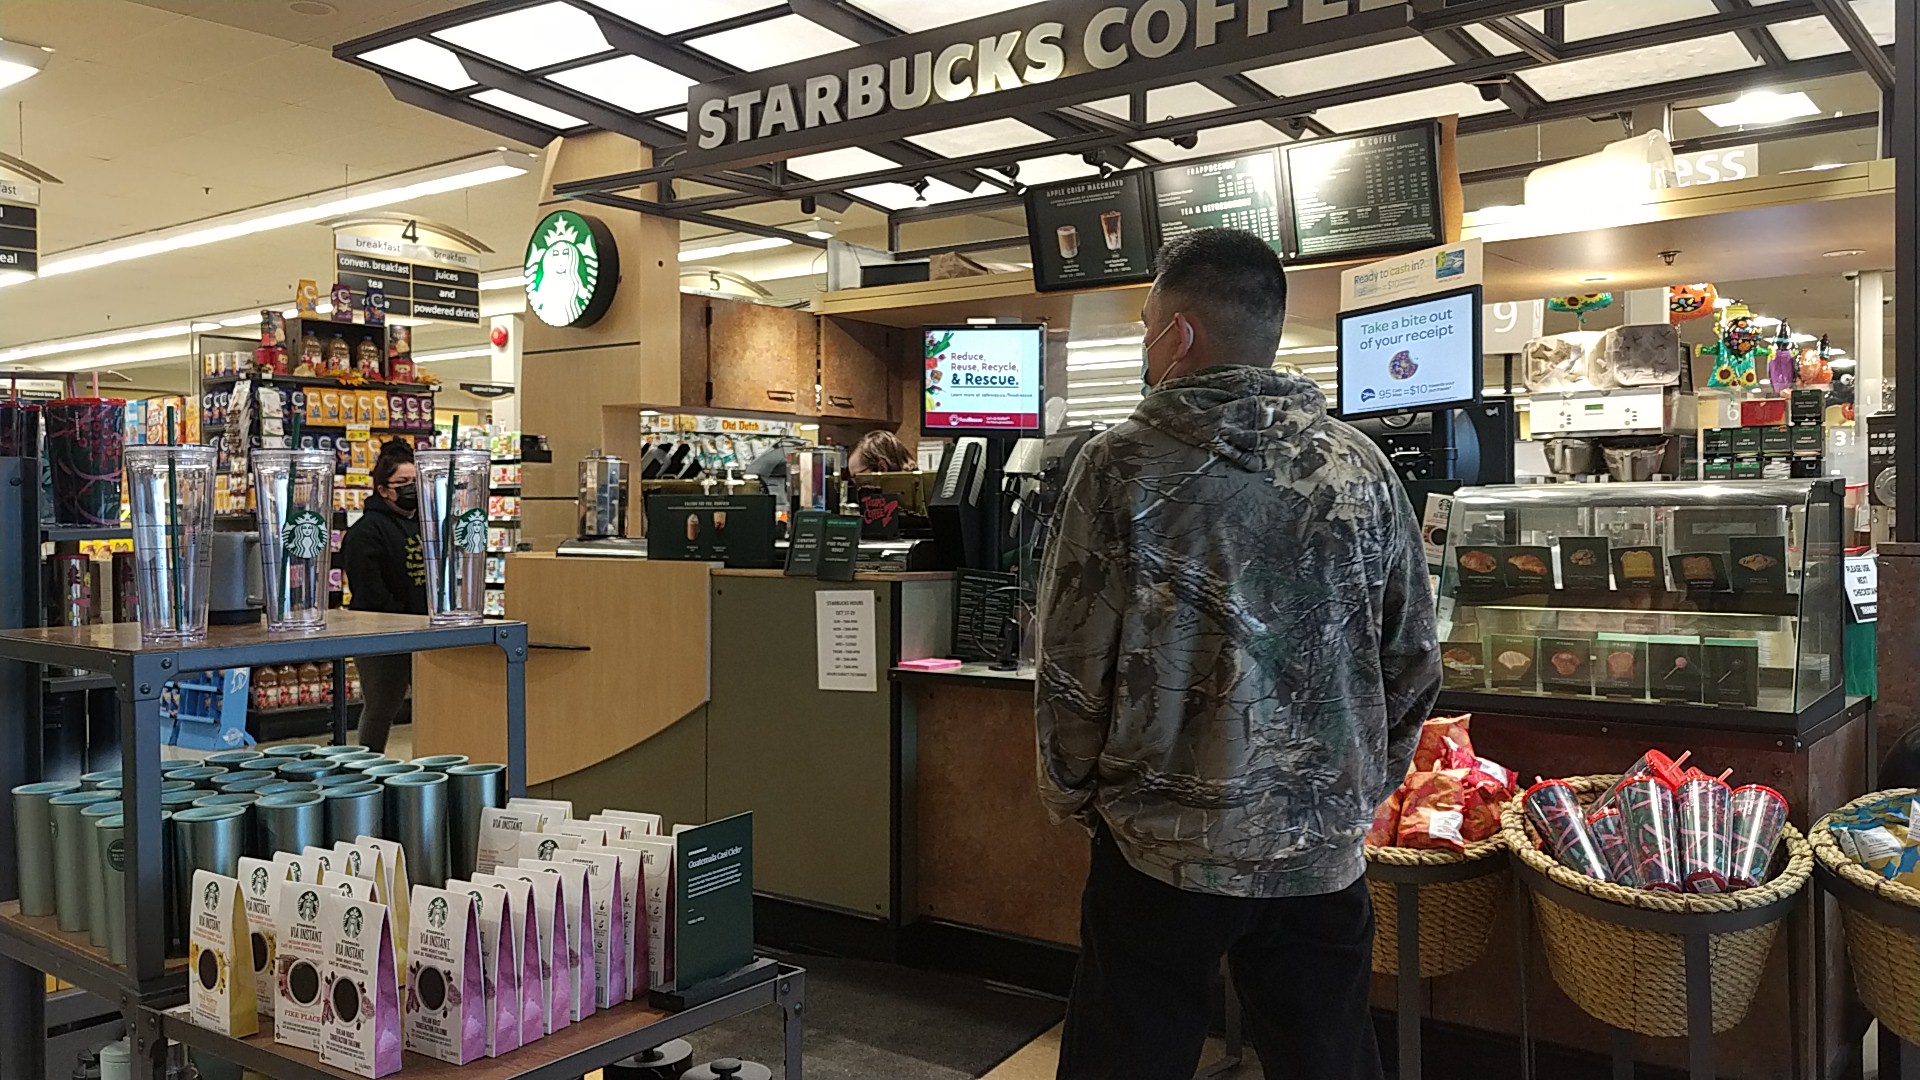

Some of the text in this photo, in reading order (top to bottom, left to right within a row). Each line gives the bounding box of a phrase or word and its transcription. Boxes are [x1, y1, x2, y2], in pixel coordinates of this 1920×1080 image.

[698, 0, 1394, 149] STARBUCKS COFF
[1368, 134, 1397, 146] COFFEE
[1674, 150, 1747, 187] ess
[1046, 188, 1066, 198] APPLE
[1066, 184, 1086, 195] CRISP
[1087, 179, 1124, 192] MACCHIATO
[1180, 206, 1194, 216] TEA
[401, 219, 419, 244] 4
[356, 238, 401, 252] breakfast
[433, 250, 467, 264] breakfast
[339, 256, 410, 275] conven. breakfast
[1354, 258, 1425, 286] Ready to cash in?
[434, 270, 459, 282] juices
[709, 270, 720, 291] 5
[367, 279, 383, 289] tea
[438, 290, 456, 299] and
[414, 305, 480, 319] powdered drinks
[1493, 302, 1518, 333] 9
[1361, 322, 1389, 336] Take
[1401, 314, 1427, 328] bite
[1429, 309, 1453, 323] out
[1360, 324, 1454, 350] of your receipt
[950, 352, 986, 362] Reduce,
[950, 362, 1019, 373] Reuse, Recycle,
[951, 373, 1019, 386] & Rescue.
[1378, 389, 1392, 400] 95
[1727, 401, 1739, 421] 6
[722, 419, 760, 432] Old Dutch
[1834, 430, 1847, 446] 3
[1862, 564, 1871, 572] USE
[492, 818, 523, 832] VIA INSTANT
[688, 854, 717, 869] Guatemala
[251, 902, 271, 917] INSTANT
[198, 914, 221, 933] VIA INSTANT
[290, 926, 323, 944] VIA INSTANT
[420, 932, 451, 950] VIA INSTANT
[335, 942, 365, 961] VIA INSTANT
[284, 1008, 321, 1024] PIKE PLACE
